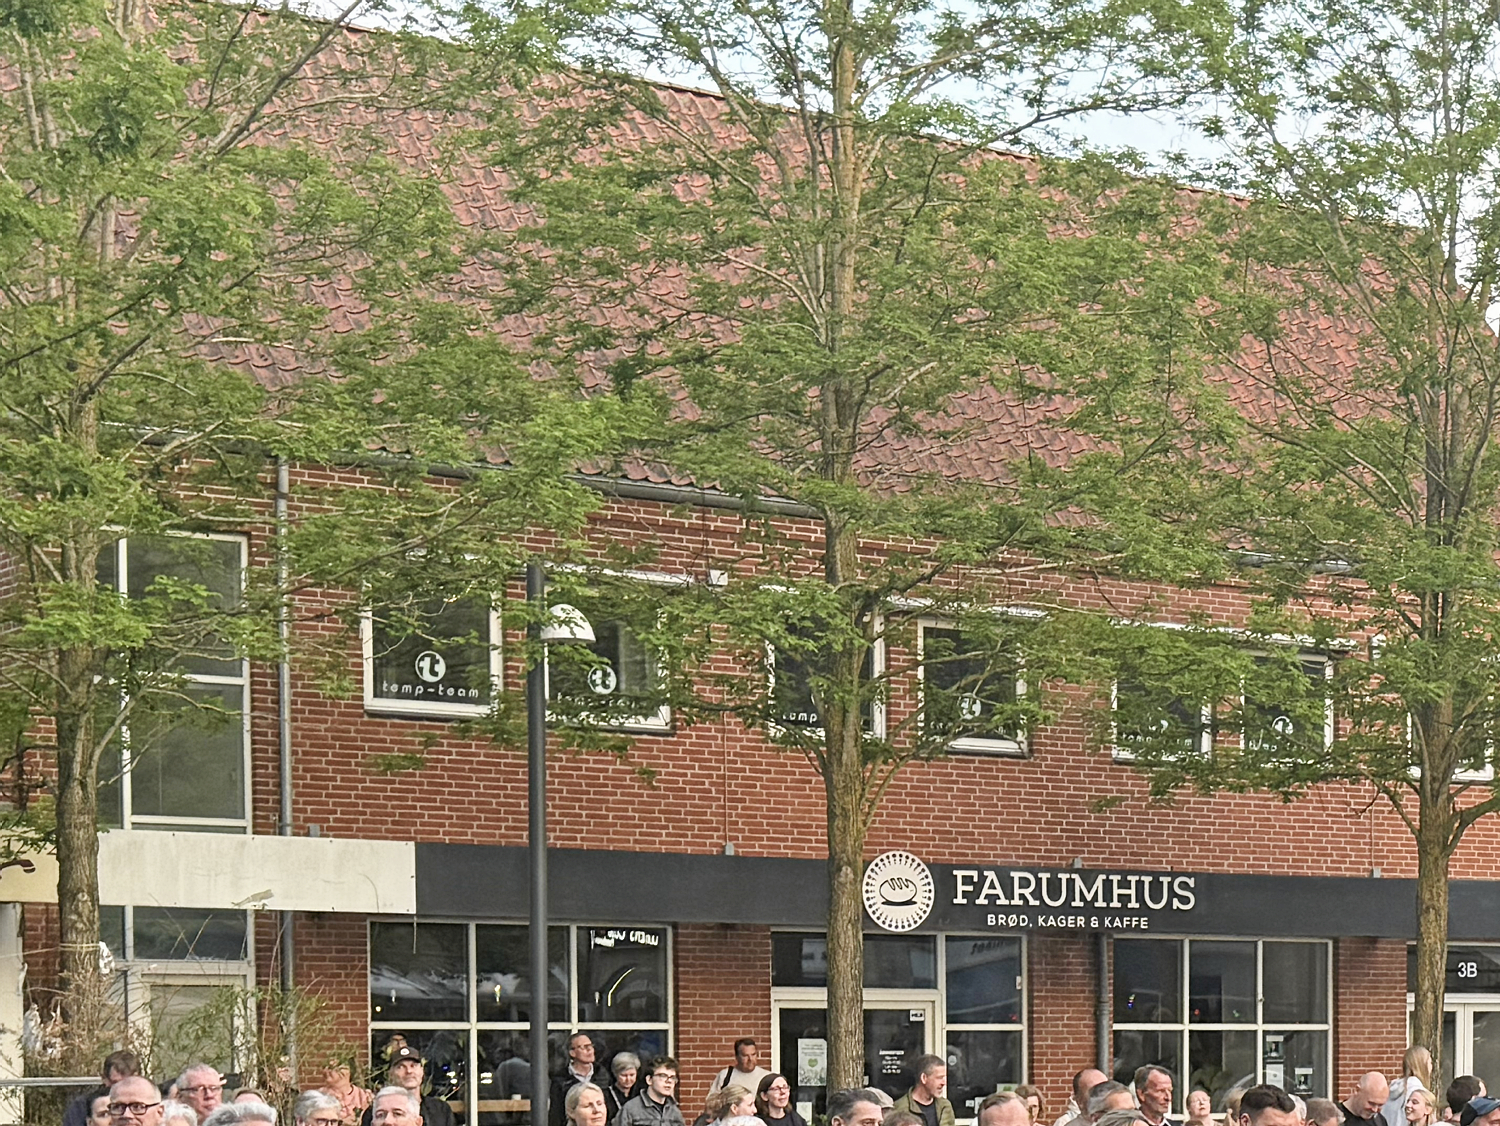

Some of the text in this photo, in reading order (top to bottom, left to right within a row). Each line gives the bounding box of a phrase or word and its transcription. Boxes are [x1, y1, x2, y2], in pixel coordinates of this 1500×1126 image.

[382, 680, 478, 698] temp-team
[952, 869, 1196, 910] FARUMHUS
[987, 914, 1148, 929] BRØD, KAGER & KAFFE
[1457, 961, 1478, 978] 3B
